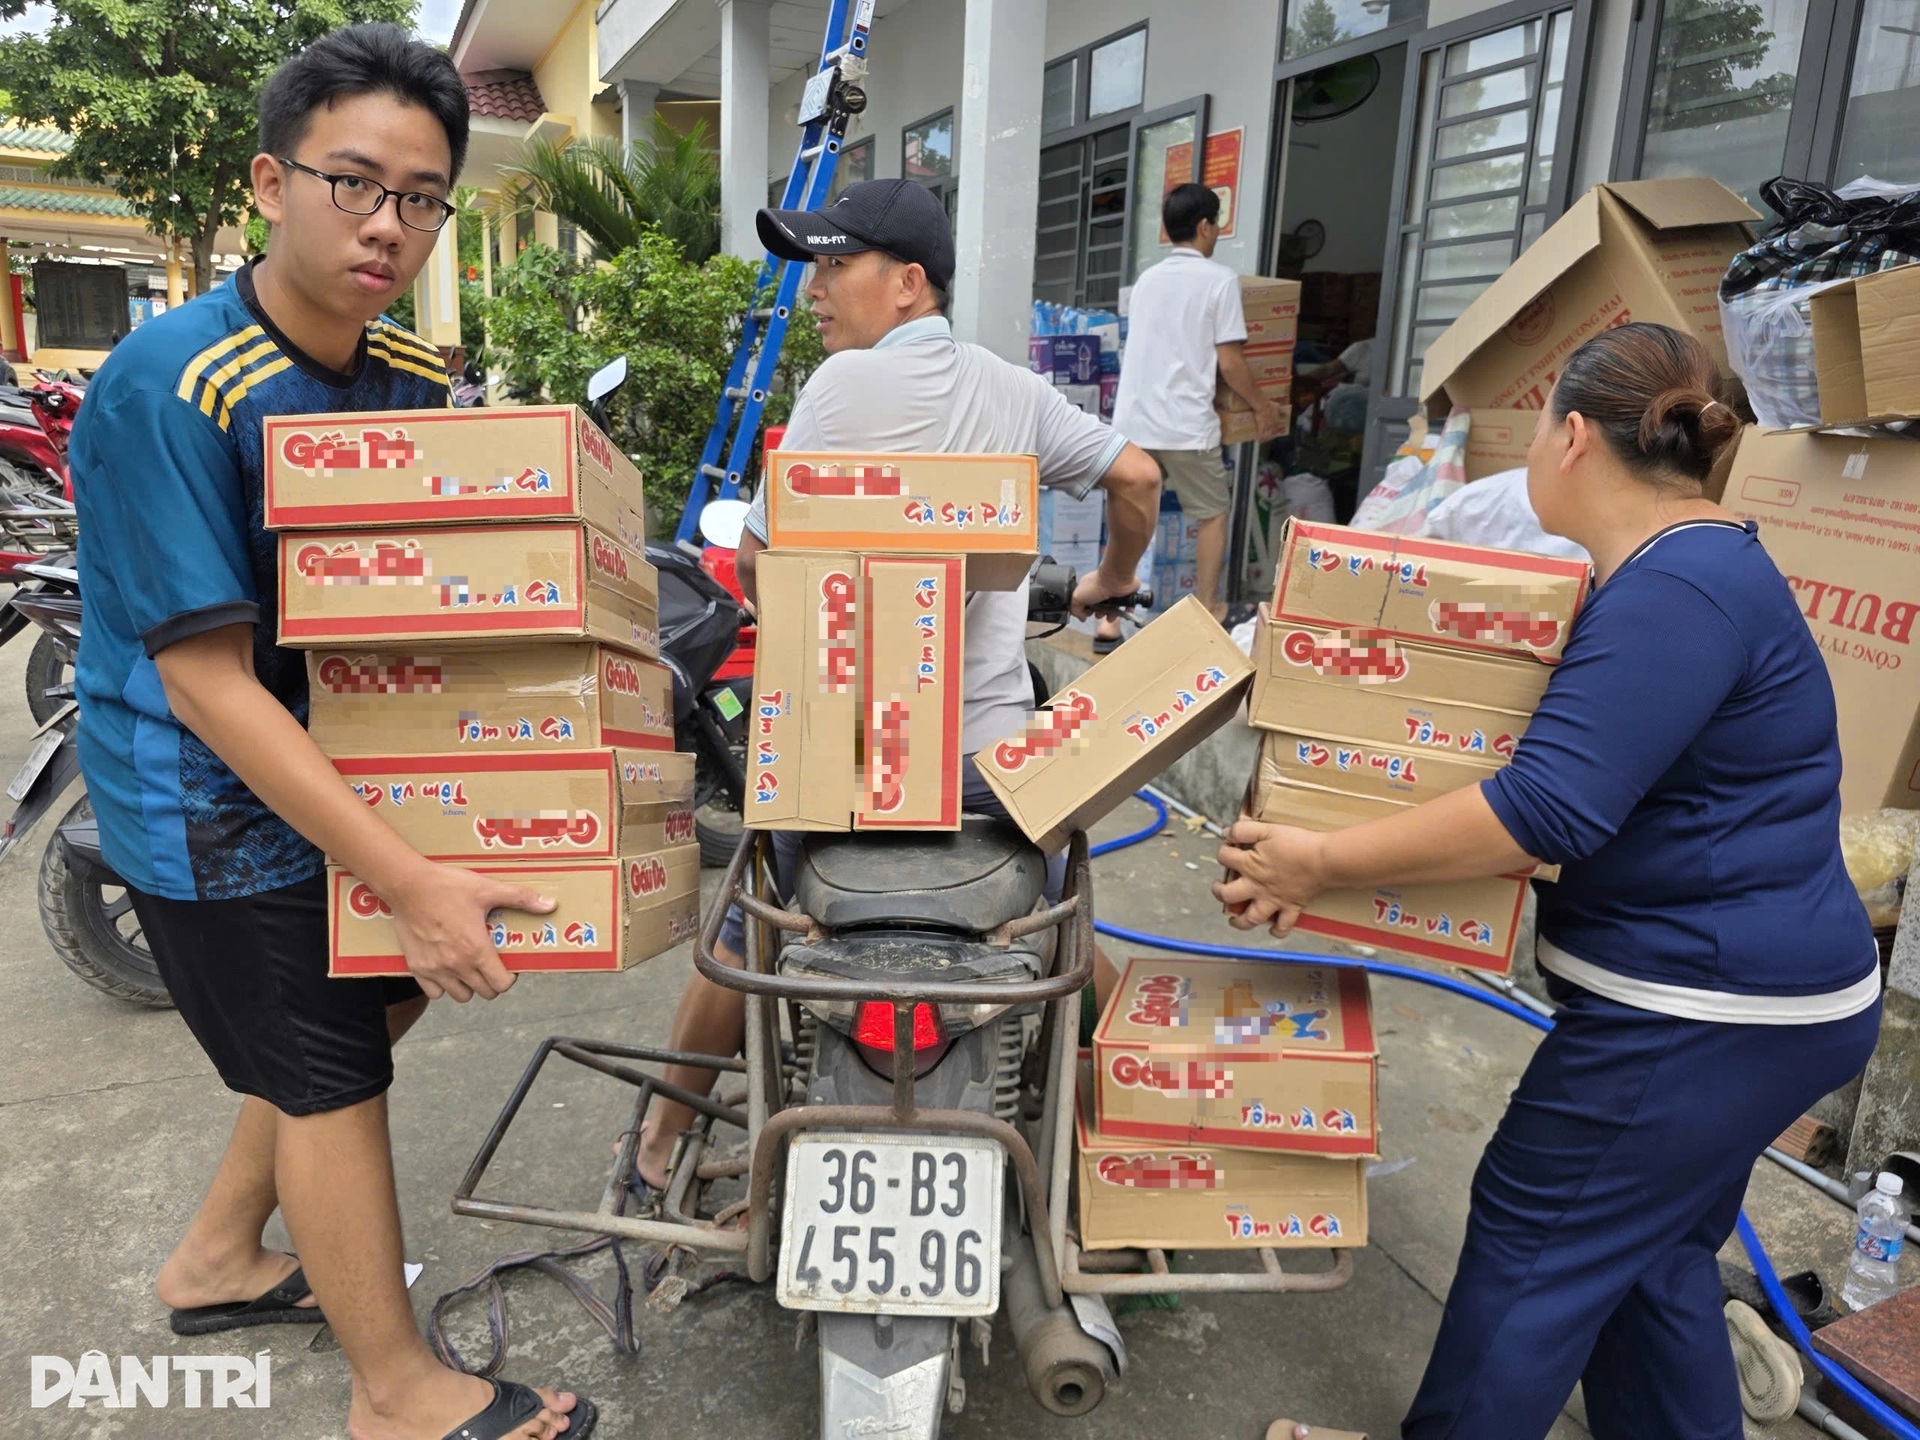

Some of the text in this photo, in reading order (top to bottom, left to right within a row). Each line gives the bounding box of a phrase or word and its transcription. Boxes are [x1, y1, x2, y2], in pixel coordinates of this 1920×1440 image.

[807, 235, 847, 245] NIKE-FIT
[516, 468, 552, 493] Gà
[904, 502, 935, 525] Gà
[941, 502, 975, 530] Sợi
[1308, 548, 1429, 588] Tôm và Gà
[525, 580, 560, 605] Gà
[914, 577, 938, 609] Gà
[914, 614, 938, 638] và
[1852, 643, 1902, 671] CÔNG
[1126, 667, 1227, 744] Tôm và Gà
[506, 717, 533, 742] và
[539, 716, 574, 742] Gà
[1404, 717, 1520, 758] Tôm và G
[756, 690, 783, 804] Tôm và Gà
[1298, 741, 1418, 783] Tôm và Gà
[390, 782, 415, 806] và
[421, 780, 469, 806] Tôm
[487, 920, 597, 948] ôm và Gà
[1373, 898, 1493, 947] Tôm và Gà
[1289, 1105, 1317, 1132] và
[1322, 1108, 1358, 1134] Gà
[819, 1149, 967, 1217] 36-B3
[1224, 1213, 1342, 1239] Tôm và Gà
[796, 1225, 982, 1297] 455.96
